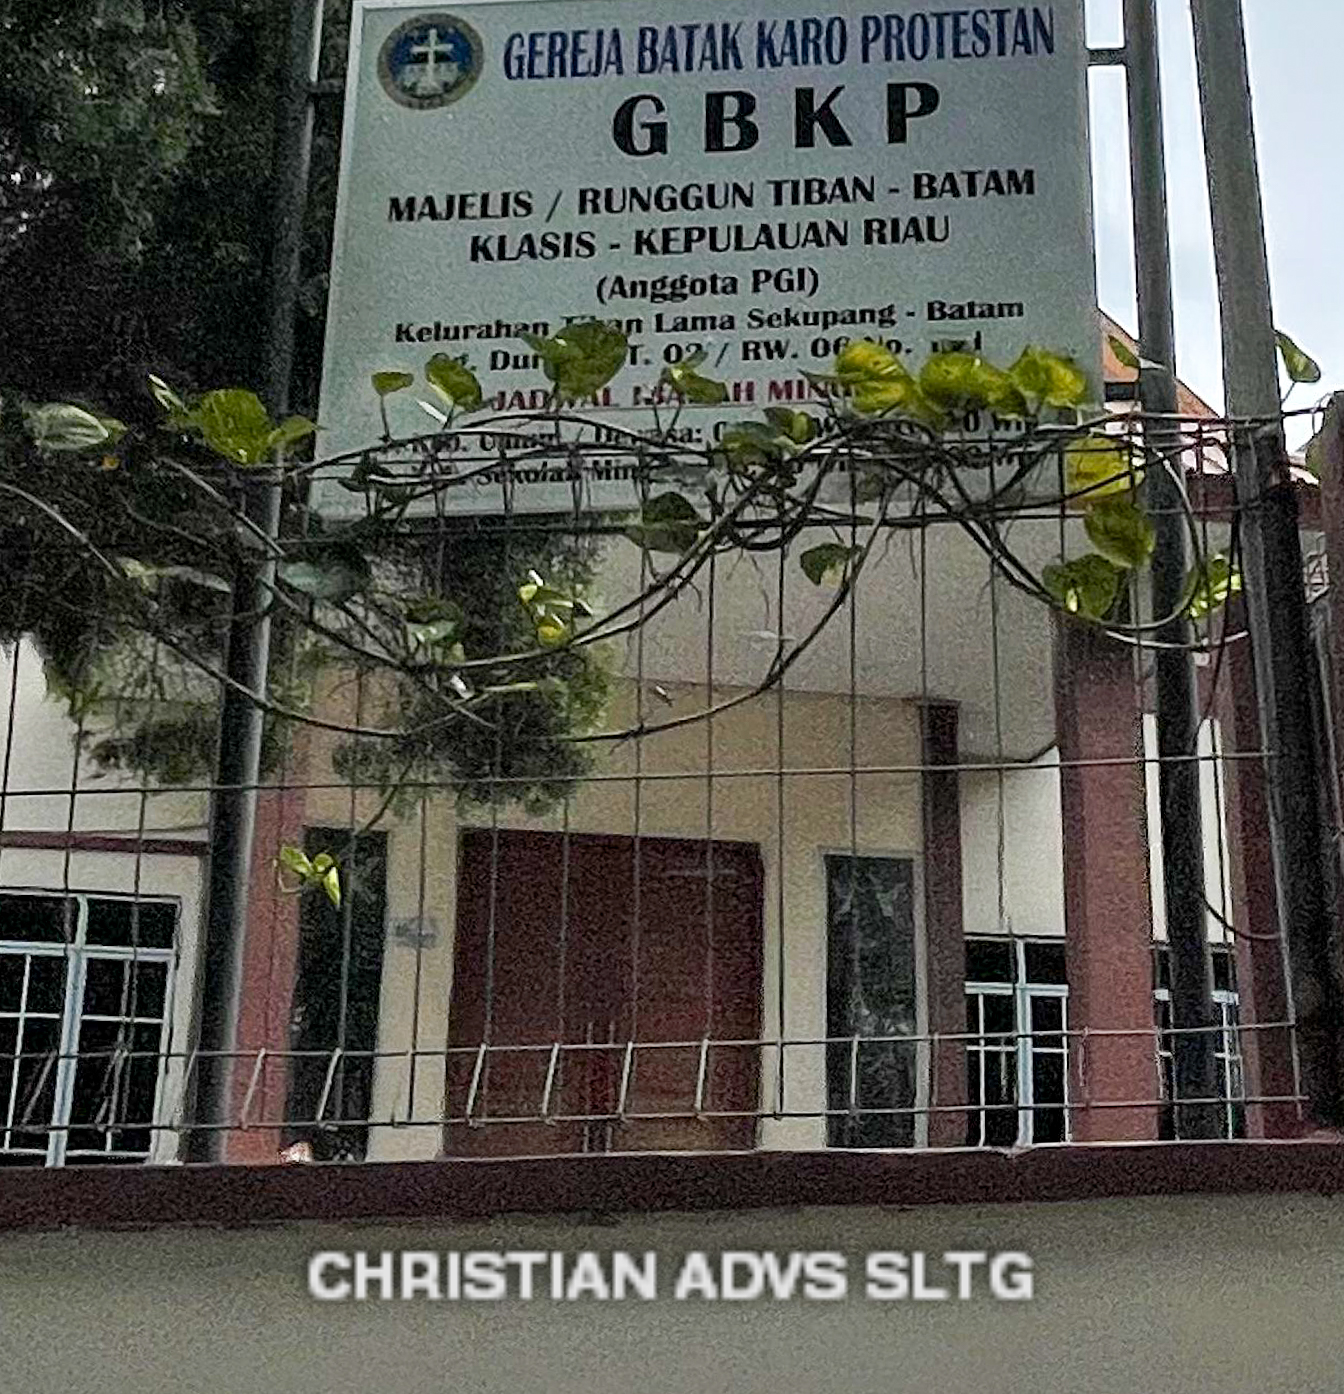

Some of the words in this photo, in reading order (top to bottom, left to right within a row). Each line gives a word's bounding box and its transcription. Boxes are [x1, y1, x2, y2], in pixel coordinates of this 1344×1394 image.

[503, 27, 624, 80] GEREJA
[637, 20, 744, 75] BATAK
[757, 15, 847, 69] KARO
[861, 6, 1054, 64] PROTESTAN
[388, 190, 534, 222] MAJELIS
[545, 189, 562, 223] /
[578, 181, 754, 216] RUNGGUN
[767, 175, 875, 208] TIBAN
[913, 169, 1035, 201] BATAM
[470, 231, 596, 263] KLASIS
[634, 219, 849, 258] KEPULAUAN
[863, 214, 950, 246] RIAU
[596, 274, 739, 305] (Anggota
[752, 265, 819, 298] PGI)
[395, 319, 550, 344] Kelurahan
[656, 311, 735, 334] Lama
[747, 303, 897, 331] Sekupang
[927, 300, 1024, 322] Batam
[741, 338, 799, 362] RW.
